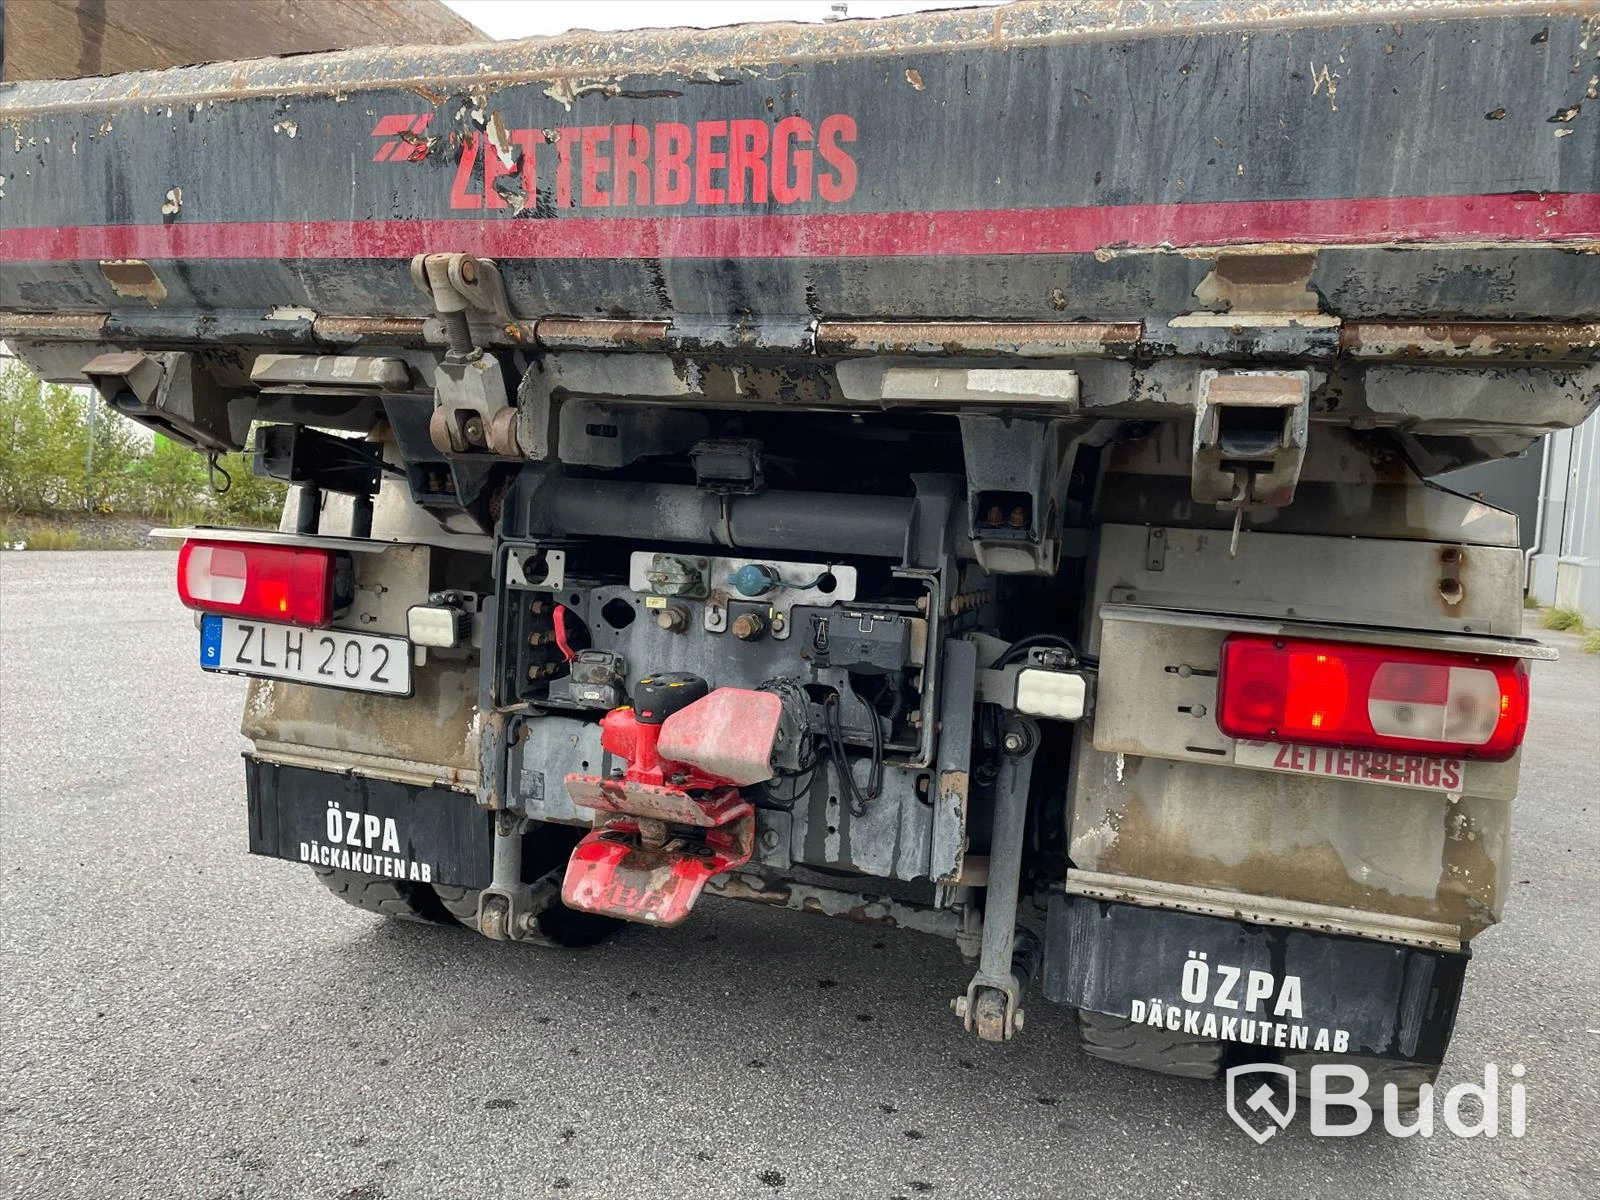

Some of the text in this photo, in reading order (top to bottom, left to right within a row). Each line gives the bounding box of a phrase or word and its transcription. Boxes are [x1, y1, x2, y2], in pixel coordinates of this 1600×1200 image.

[206, 646, 215, 658] S
[235, 624, 390, 683] ZLH 202
[1273, 743, 1461, 789] ZETTERBERGS
[326, 800, 401, 854] ÖZPA
[299, 840, 432, 883] DÄCKAKUTEN AB
[1181, 950, 1303, 1019] ÖZPA
[1130, 998, 1351, 1053] DÄCKAKUTEN AB
